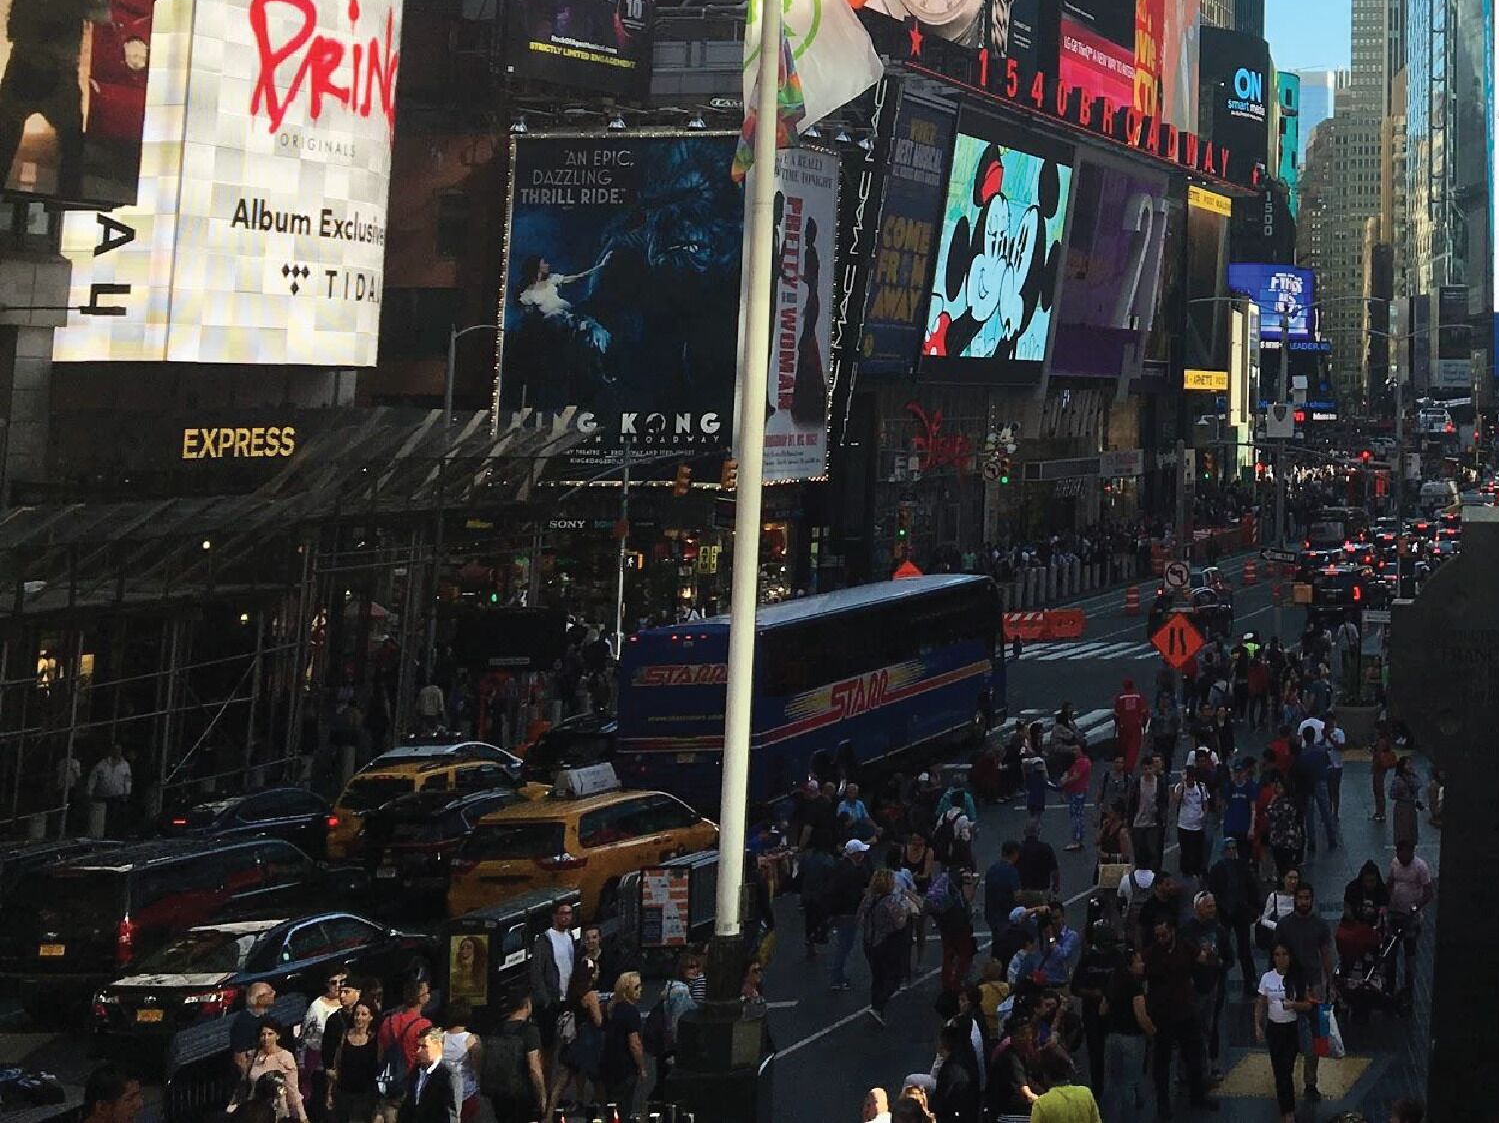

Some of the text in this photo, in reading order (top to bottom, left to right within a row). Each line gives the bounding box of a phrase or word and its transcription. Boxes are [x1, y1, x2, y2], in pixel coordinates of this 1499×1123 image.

[1234, 67, 1262, 103] ON
[977, 48, 1068, 117] 1540
[1080, 90, 1230, 178] BROADWAY
[280, 132, 356, 159] ORIGINALS
[532, 169, 613, 186] DAZZLING
[520, 188, 576, 205] THRILL
[231, 198, 312, 236] Album
[1263, 190, 1274, 237] 1500
[621, 411, 722, 434] KONG
[182, 427, 296, 460] EXPRESS
[549, 520, 587, 529] SONY
[831, 668, 890, 717] STARR
